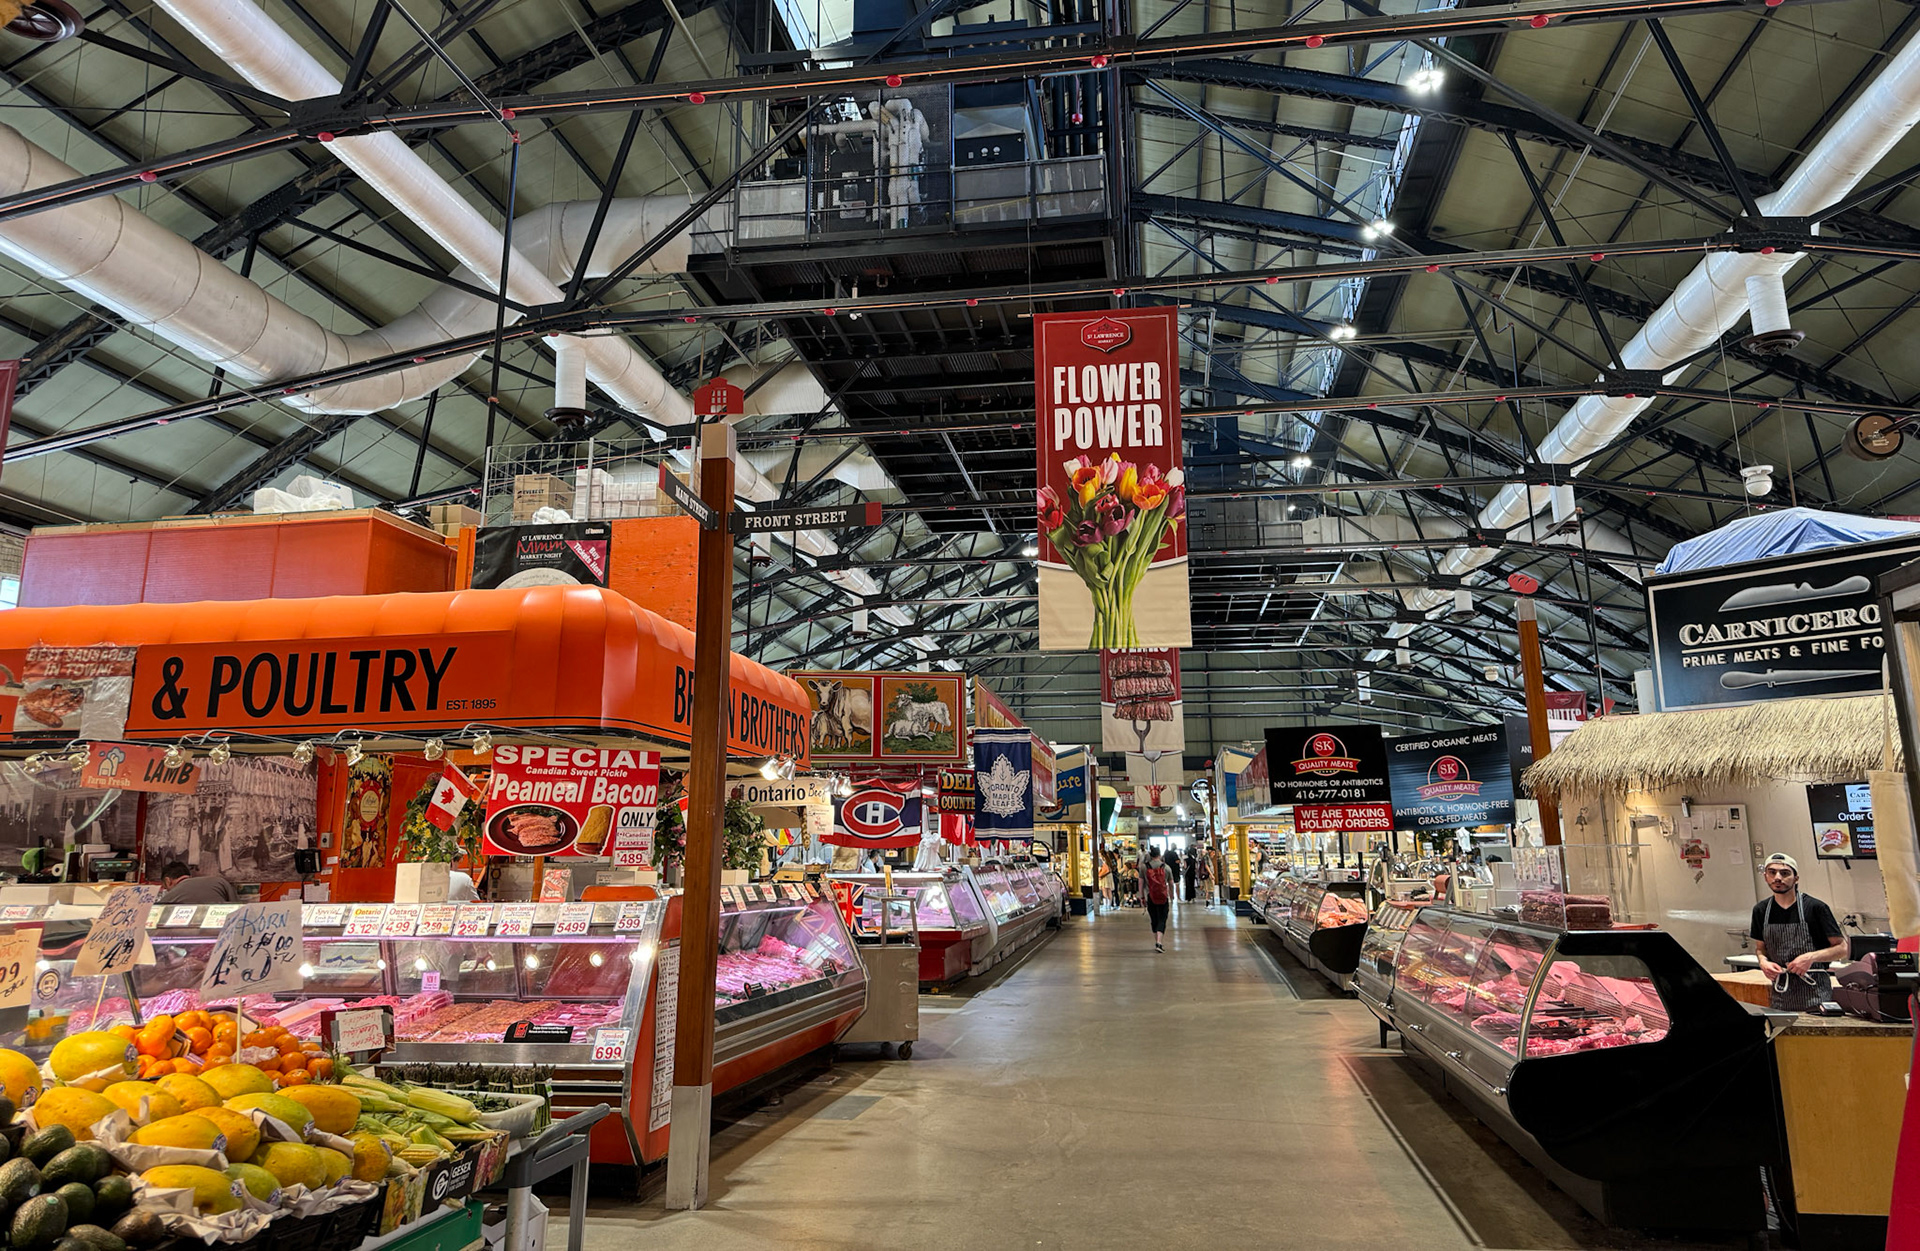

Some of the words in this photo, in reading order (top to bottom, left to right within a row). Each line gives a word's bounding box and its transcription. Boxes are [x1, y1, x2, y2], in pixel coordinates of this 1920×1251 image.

[1094, 332, 1124, 340] LAWRENCE
[1053, 362, 1162, 404] FLOWER
[1054, 404, 1163, 451] POWER
[674, 485, 690, 505] MAIN
[688, 498, 709, 522] STREET
[744, 514, 791, 529] FRONT
[794, 510, 847, 526] STREET
[573, 542, 592, 564] Tickets
[590, 559, 604, 576] Here
[588, 546, 600, 560] Buy
[26, 648, 64, 662] BEST
[1682, 653, 1727, 668] PRIME
[1733, 646, 1782, 664] MEATS
[1789, 645, 1802, 658] &
[1811, 639, 1850, 655] FINE
[44, 663, 62, 676] IN
[152, 656, 189, 721] &
[206, 646, 458, 719] POULTRY
[446, 699, 469, 711] EST.
[471, 699, 496, 710] 1895
[740, 692, 805, 760] BROTHERS
[1315, 740, 1332, 751] SK
[1395, 741, 1430, 752] CERTIFIED
[1432, 736, 1470, 749] ORGANIC
[1472, 732, 1498, 744] MEATS
[494, 745, 658, 770] SPECIAL
[143, 758, 194, 785] LAMB
[526, 766, 568, 776] Canadian
[570, 767, 598, 777] Sweet
[600, 768, 628, 778] Pickle
[1298, 760, 1328, 770] QUALITY
[1330, 760, 1354, 768] MEATS
[1440, 762, 1456, 774] SK
[88, 776, 106, 784] Farm
[108, 776, 130, 786] Fresh
[1287, 780, 1328, 788] HORMONES
[1342, 778, 1384, 786] ANTIBIOTICS
[492, 773, 587, 803] Peameal
[590, 776, 657, 804] Bacon
[748, 784, 806, 802] Ontario
[988, 784, 1020, 794] TORONTO
[1296, 788, 1366, 800] 416-777-0181
[1424, 784, 1452, 796] QUALITY
[1452, 784, 1476, 792] MEATS
[1301, 810, 1318, 820] WE
[1321, 809, 1343, 818] ARE
[1347, 808, 1385, 818] TAKING
[1396, 806, 1437, 816] ANTIBIOTIC
[1438, 805, 1445, 813] &
[1446, 800, 1509, 812] HORMONE-FREE
[620, 812, 654, 827] ONLY
[1300, 818, 1344, 829] HOLIDAY
[1346, 818, 1390, 828] ORDERS
[1418, 816, 1456, 826] GRASS-FED
[1456, 812, 1488, 823] MEATS
[1838, 812, 1866, 821] Order
[354, 908, 382, 916] Ontario
[390, 908, 418, 916] Ontario
[452, 1160, 473, 1178] GESEX
